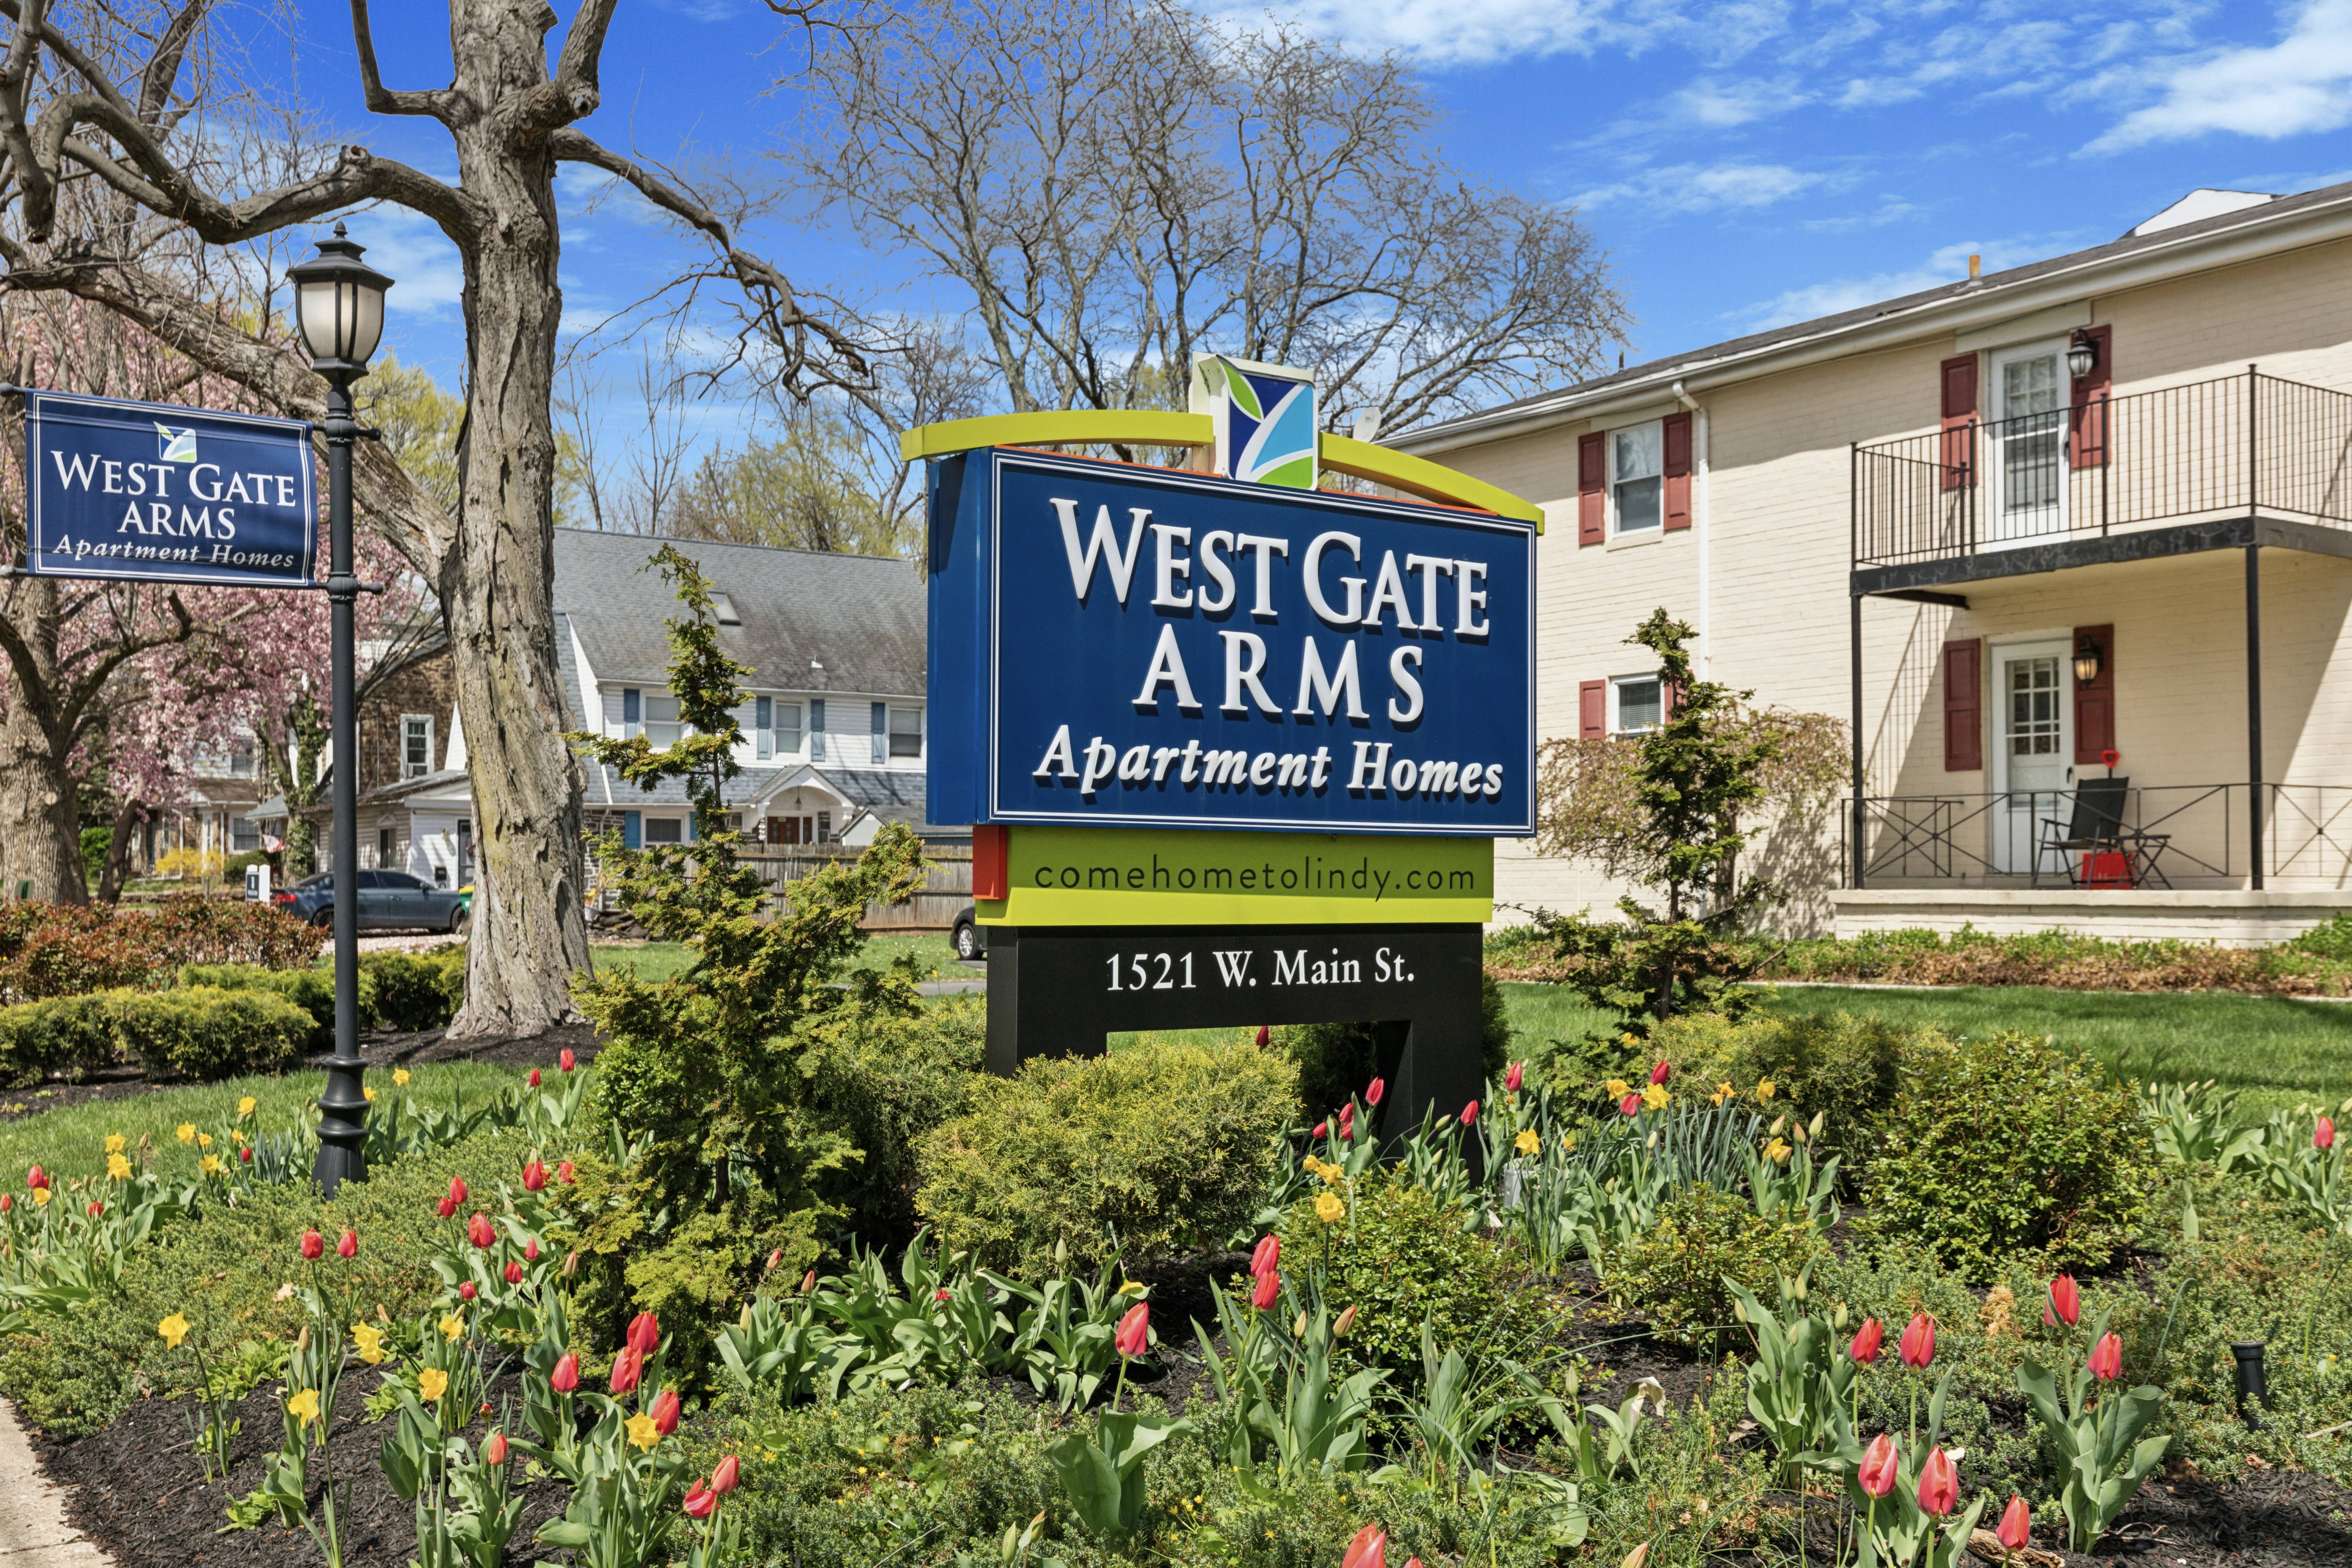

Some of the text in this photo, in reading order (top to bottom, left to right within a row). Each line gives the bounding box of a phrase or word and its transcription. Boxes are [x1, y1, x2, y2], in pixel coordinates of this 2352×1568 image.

[51, 450, 296, 508] WEST GATE
[117, 500, 236, 540] ARMS
[52, 534, 294, 567] Apartment Homes
[1049, 497, 1490, 636] WEST GATE
[1131, 623, 1424, 723] ARMS
[1032, 724, 1504, 795] Apartment Homes
[1034, 854, 1474, 902] comehometolindy.com
[1107, 947, 1414, 991] 1521 W. Main St.
